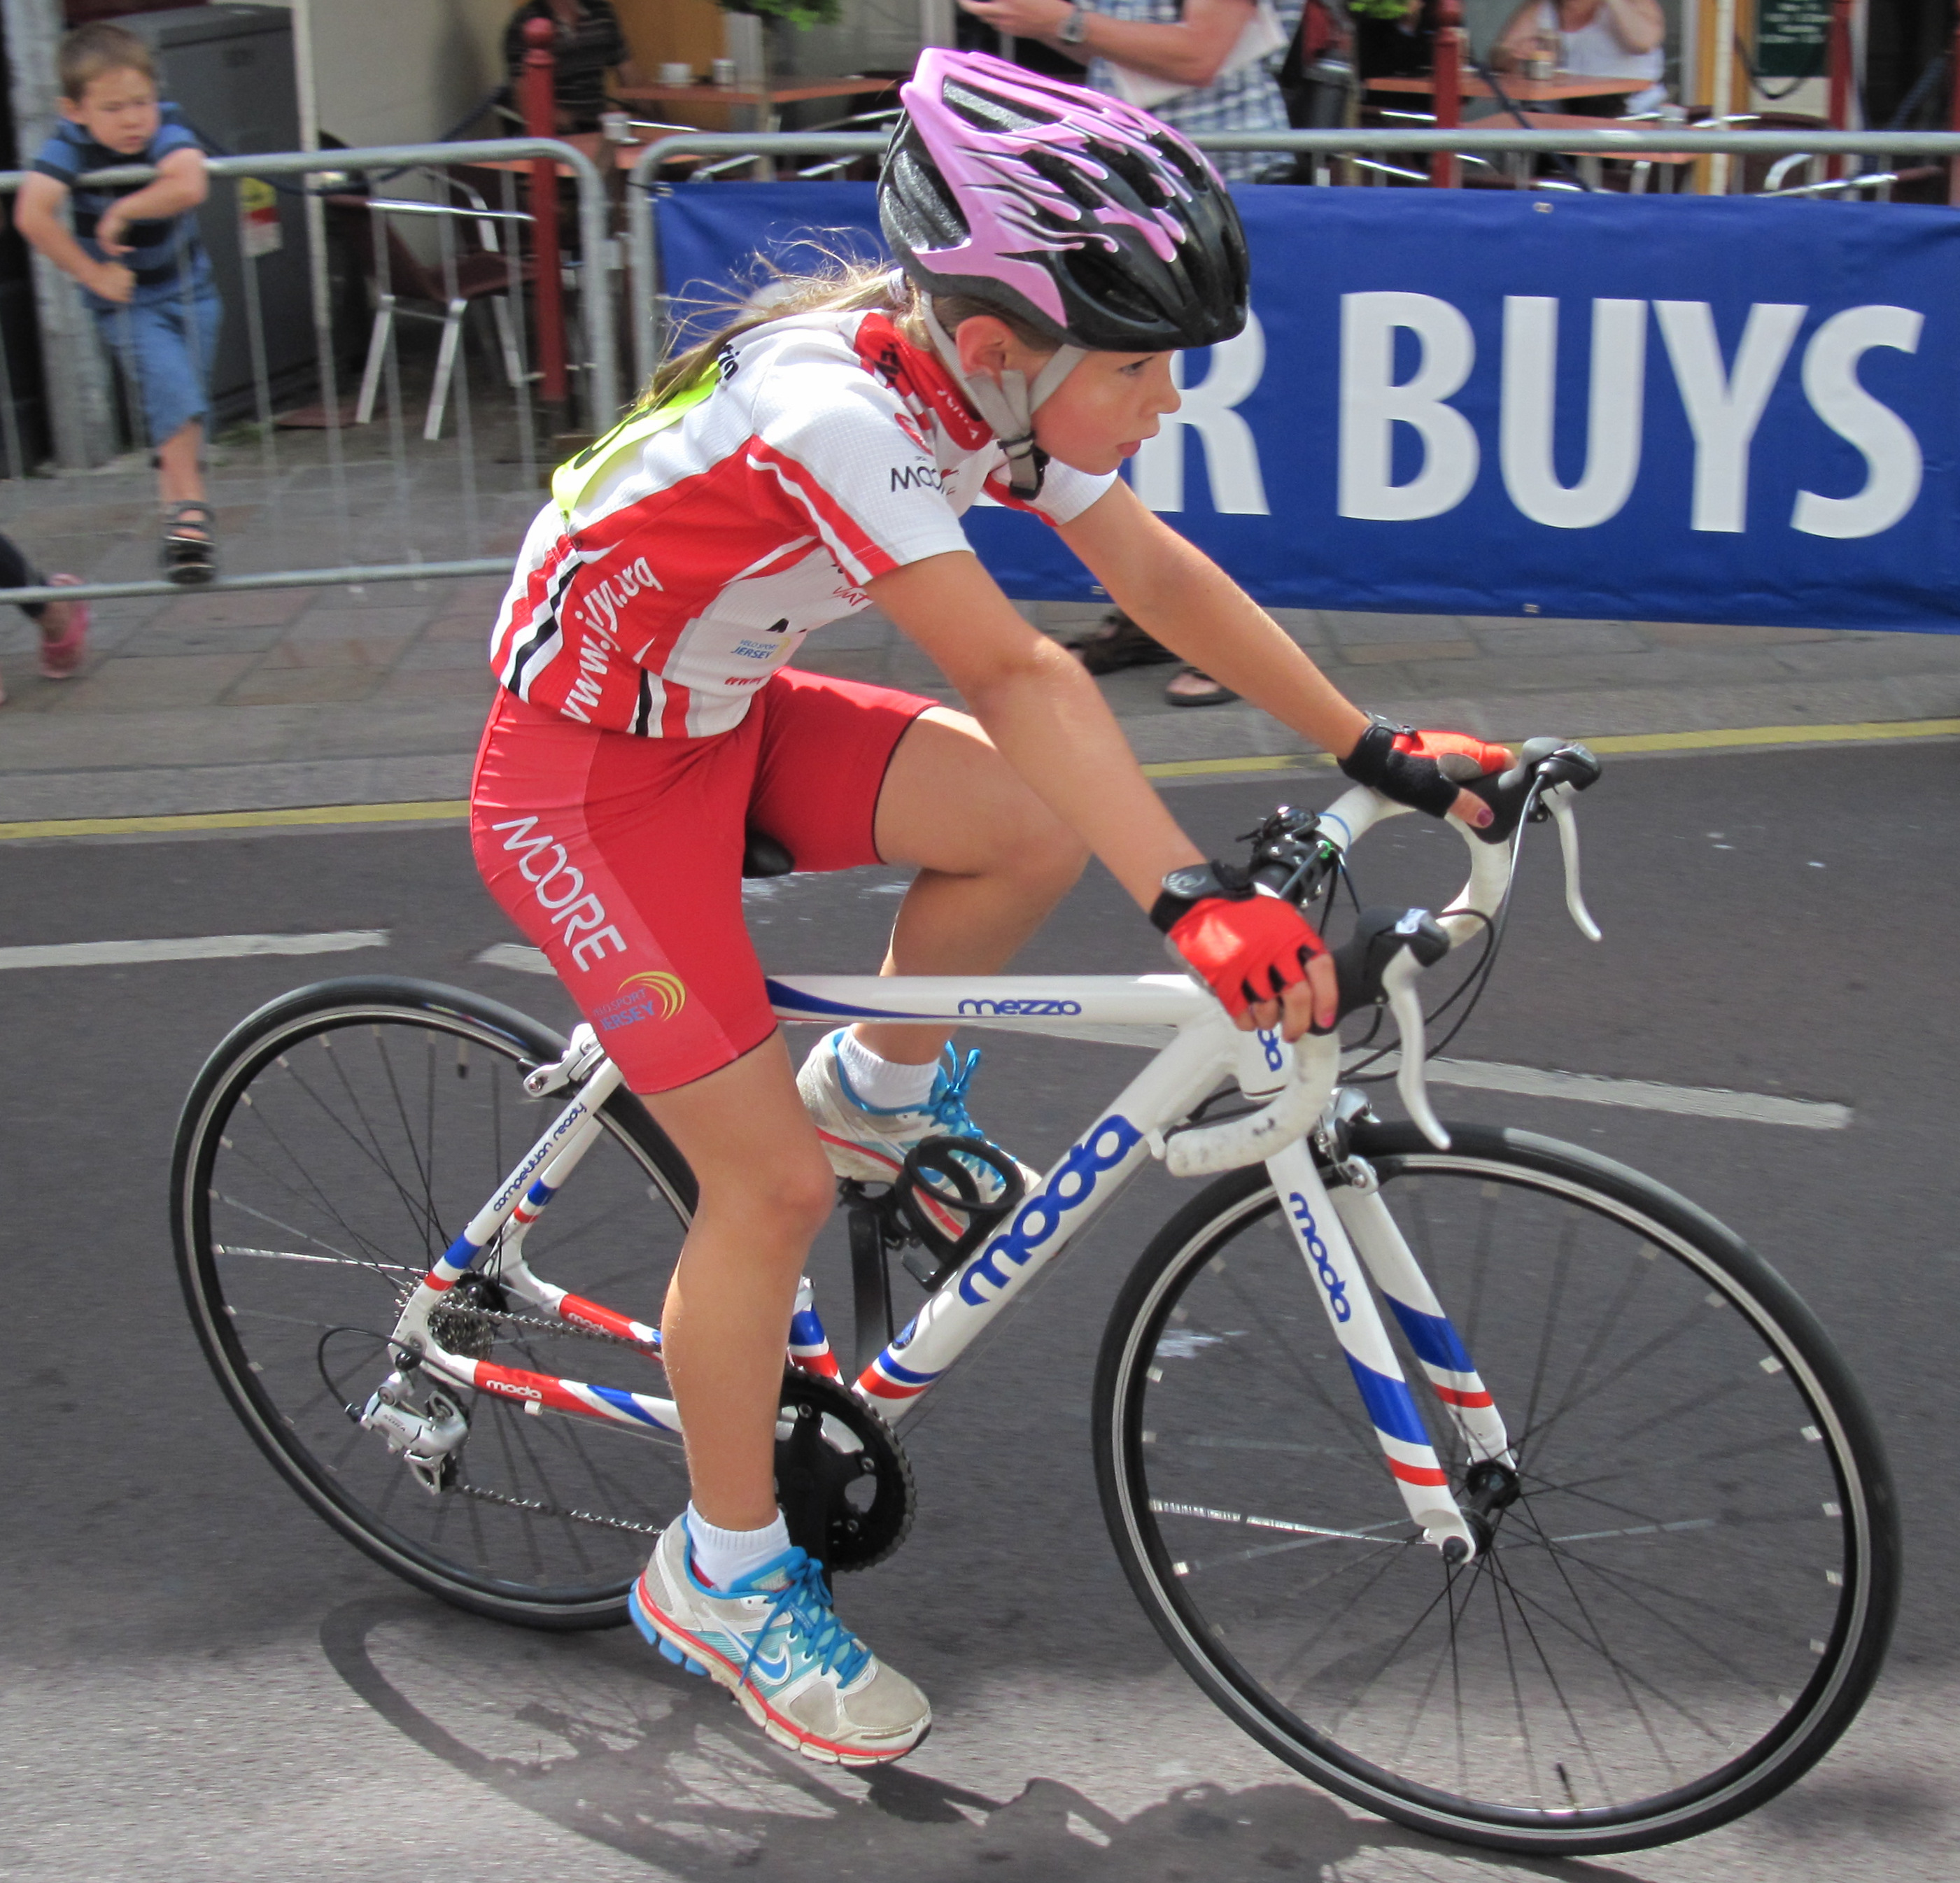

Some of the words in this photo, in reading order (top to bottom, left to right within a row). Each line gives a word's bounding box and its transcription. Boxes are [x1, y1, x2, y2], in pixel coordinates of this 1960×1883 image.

[1337, 290, 1925, 539] BUYS
[731, 646, 775, 659] JERSEY
[492, 815, 627, 973] MOORE
[611, 987, 646, 1010] SPORT
[958, 999, 1082, 1016] mezzo
[493, 1141, 553, 1213] competition
[553, 1101, 587, 1141] ready
[958, 1114, 1145, 1306] moda
[1289, 1192, 1351, 1323] moda
[486, 1379, 542, 1399] moda
